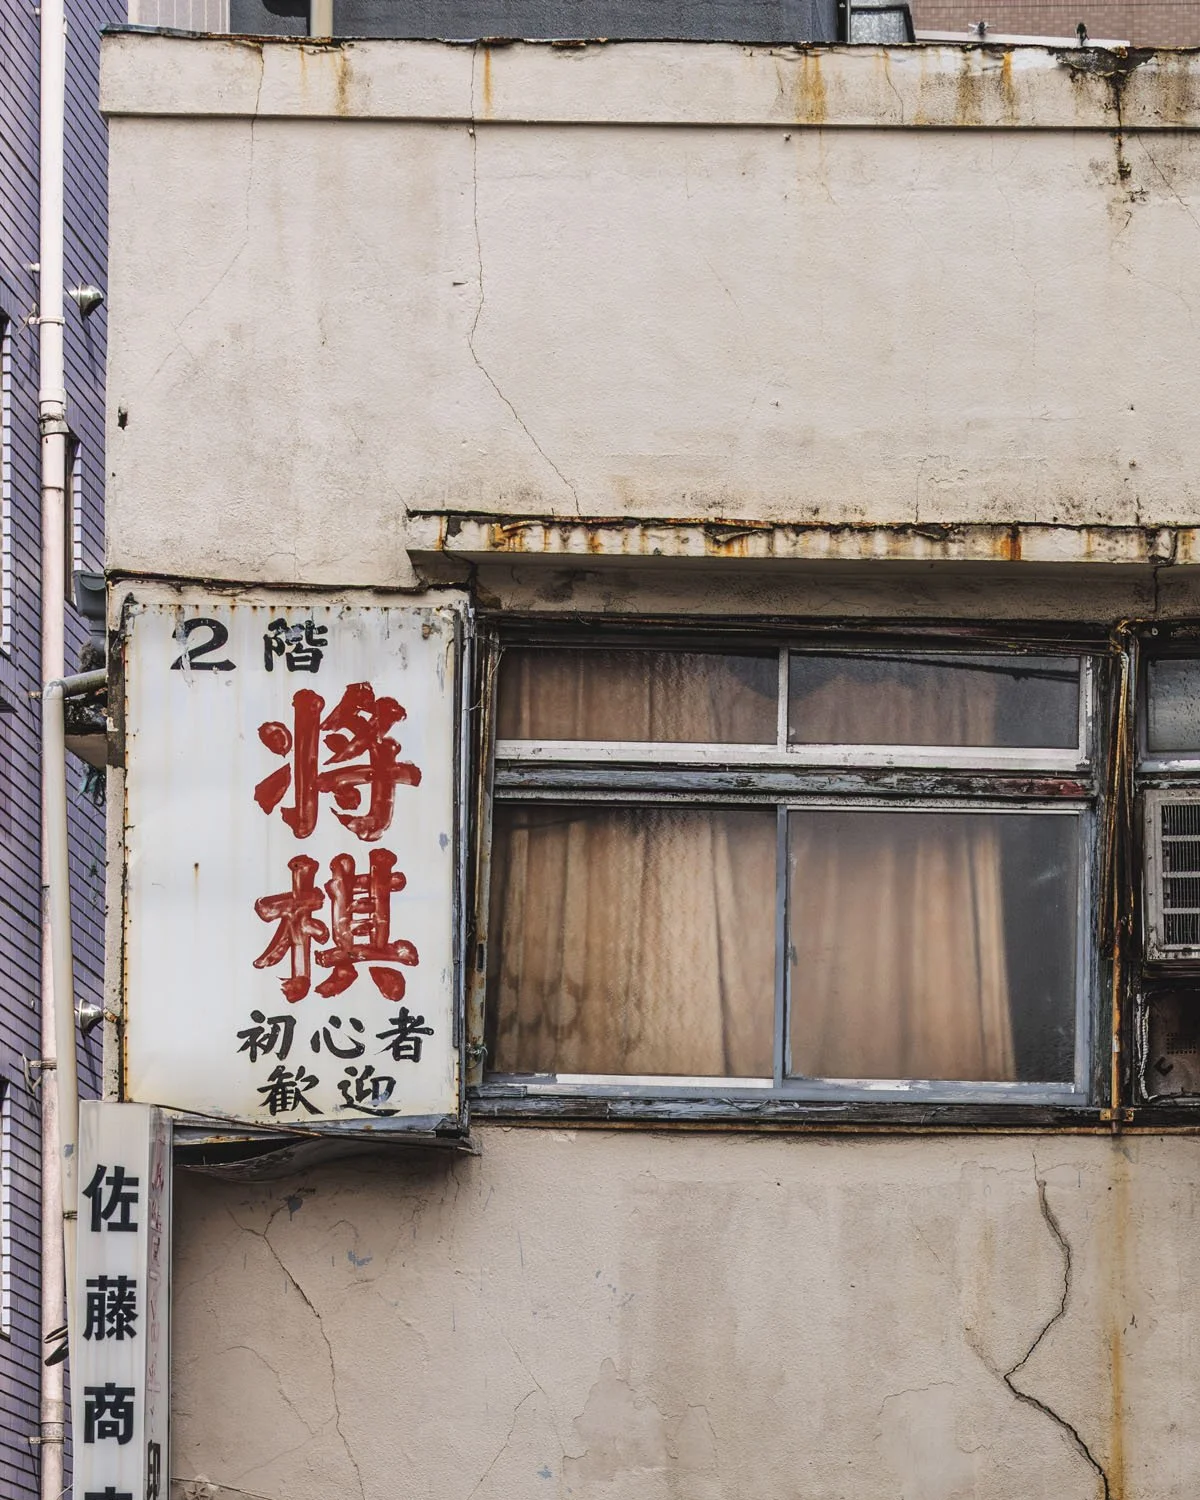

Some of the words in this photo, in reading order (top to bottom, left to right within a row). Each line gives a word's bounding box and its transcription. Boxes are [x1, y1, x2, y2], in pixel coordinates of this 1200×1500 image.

[171, 617, 329, 674] 2階
[253, 681, 422, 1003] 将棋
[236, 1006, 435, 1063] 初心者
[257, 1064, 402, 1117] 歓迎
